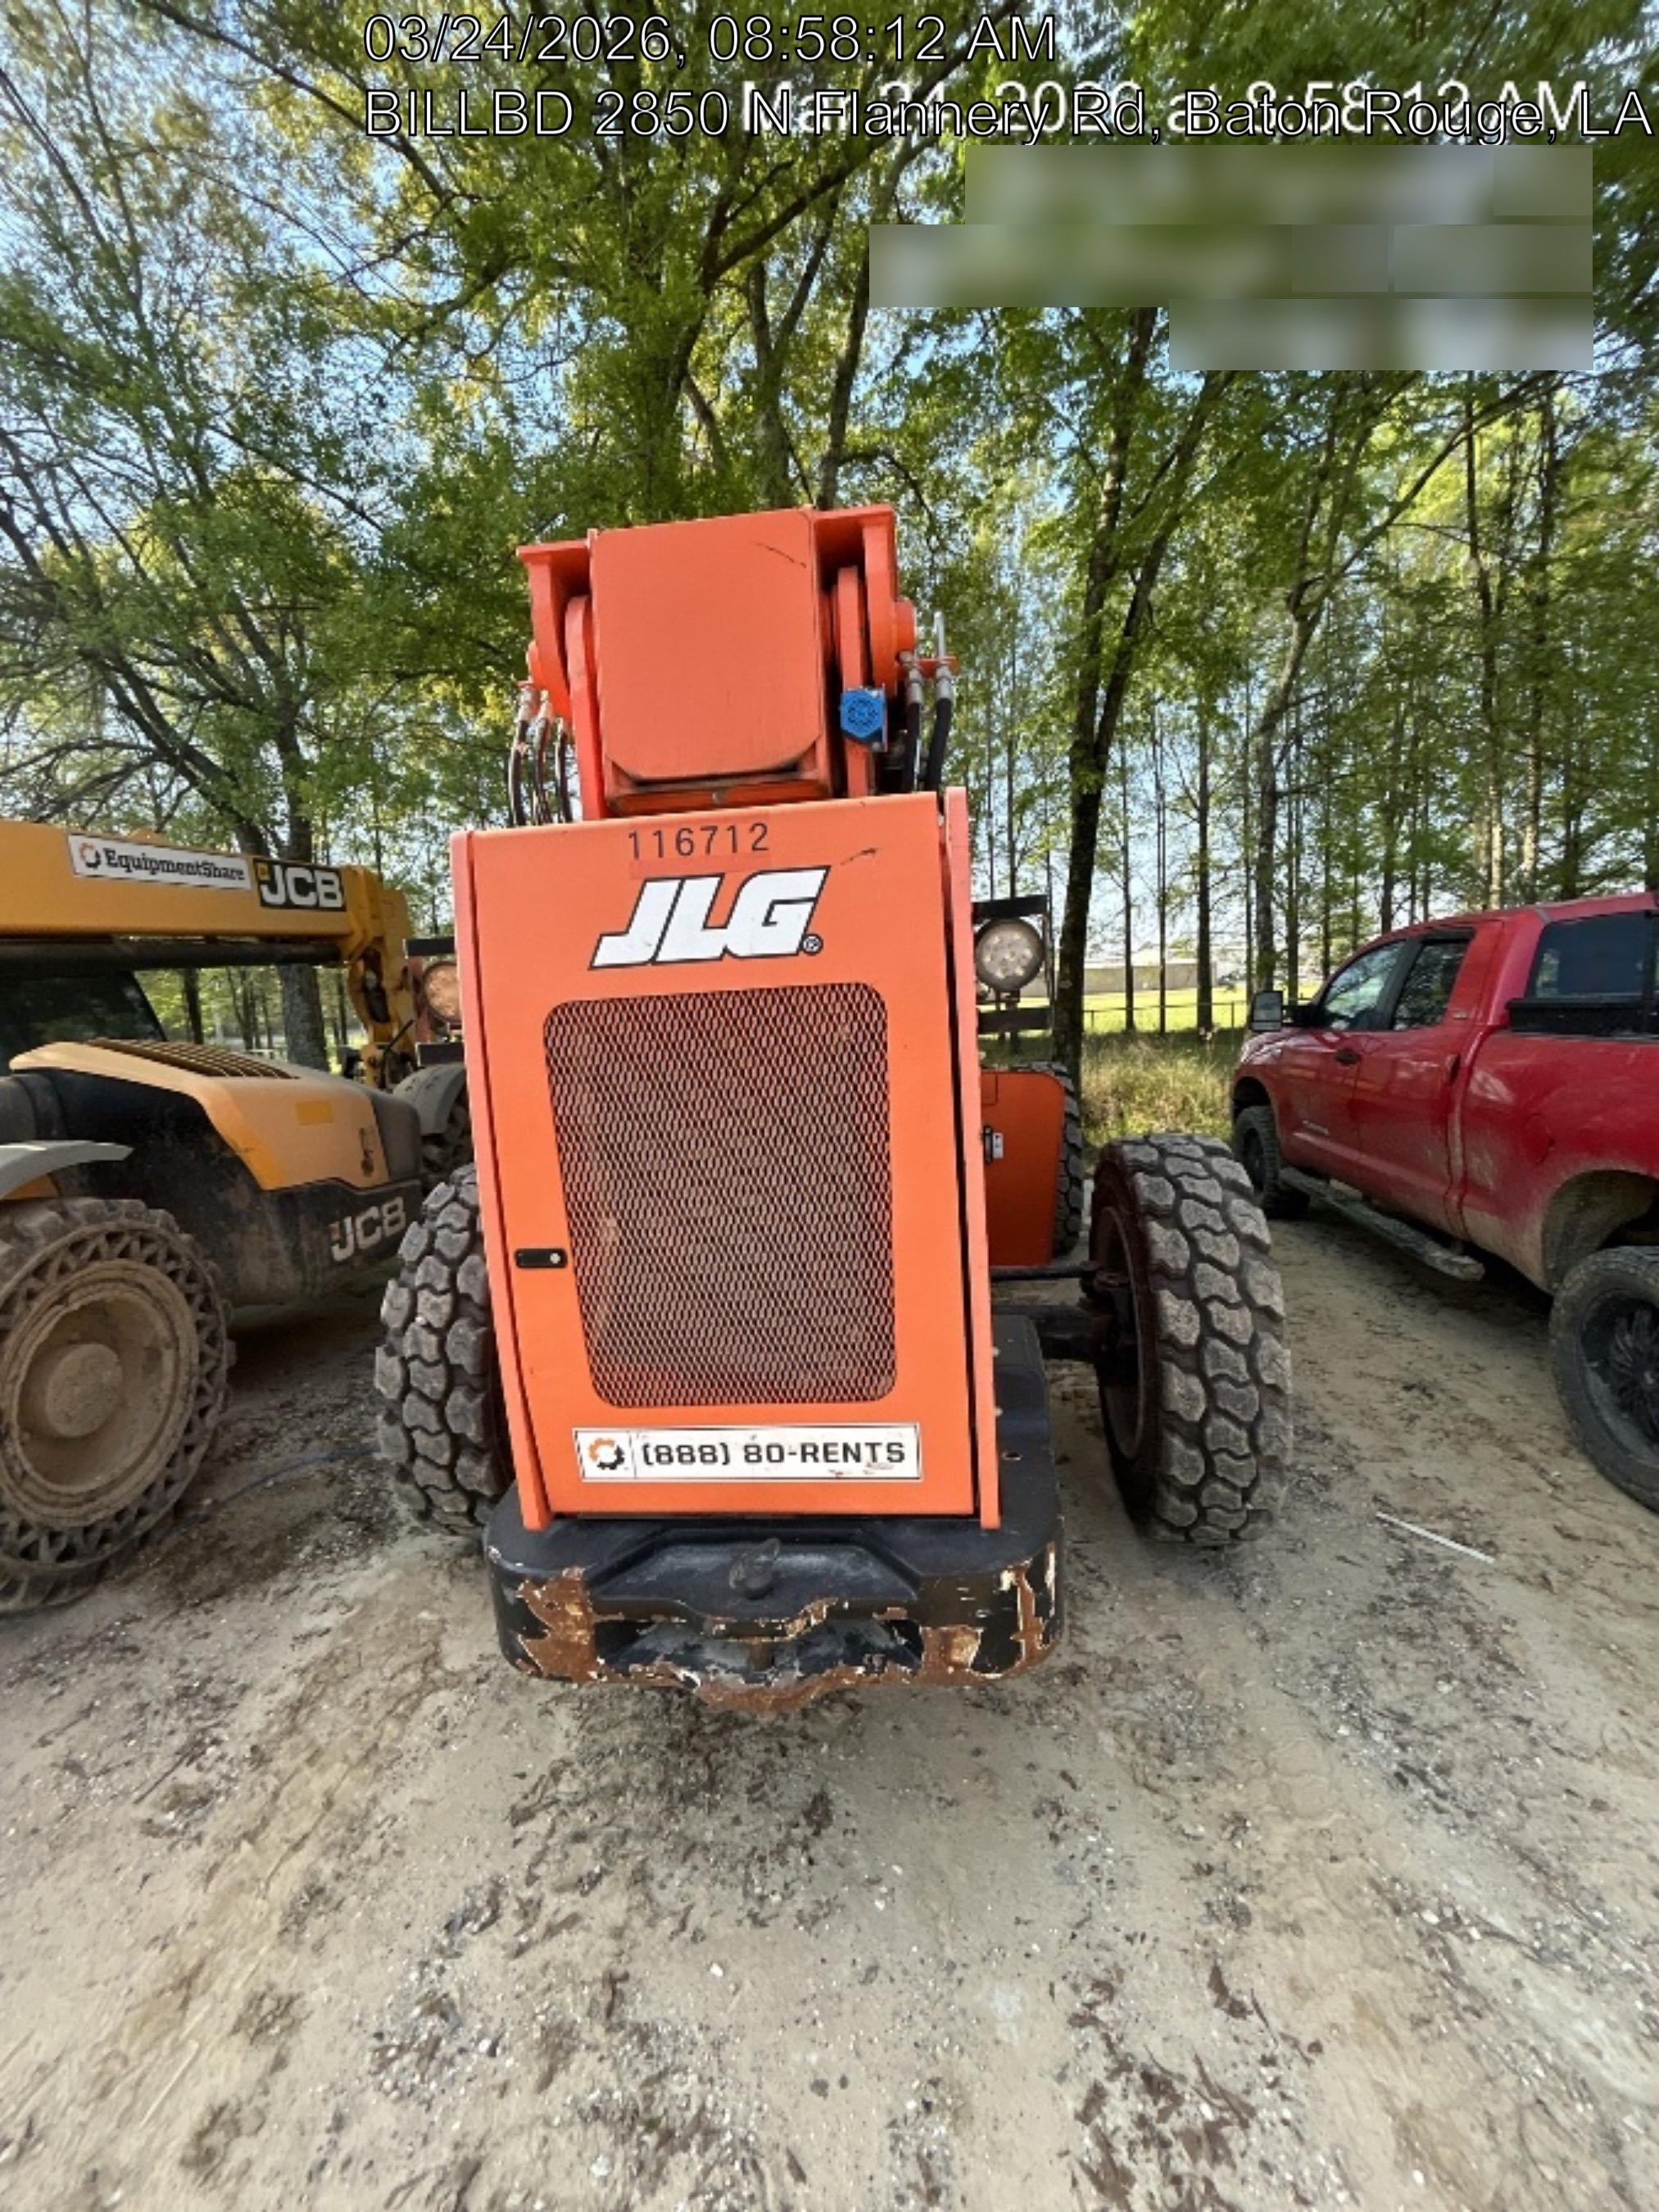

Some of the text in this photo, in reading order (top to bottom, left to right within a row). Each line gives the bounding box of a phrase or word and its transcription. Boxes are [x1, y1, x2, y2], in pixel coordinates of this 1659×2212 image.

[628, 823, 769, 859] 116712
[103, 847, 245, 881] EquipmentShare
[258, 863, 343, 909] JCB
[588, 864, 831, 970] JLG
[329, 1196, 406, 1262] JCB
[642, 1442, 906, 1466] (888) 80-RENTS
